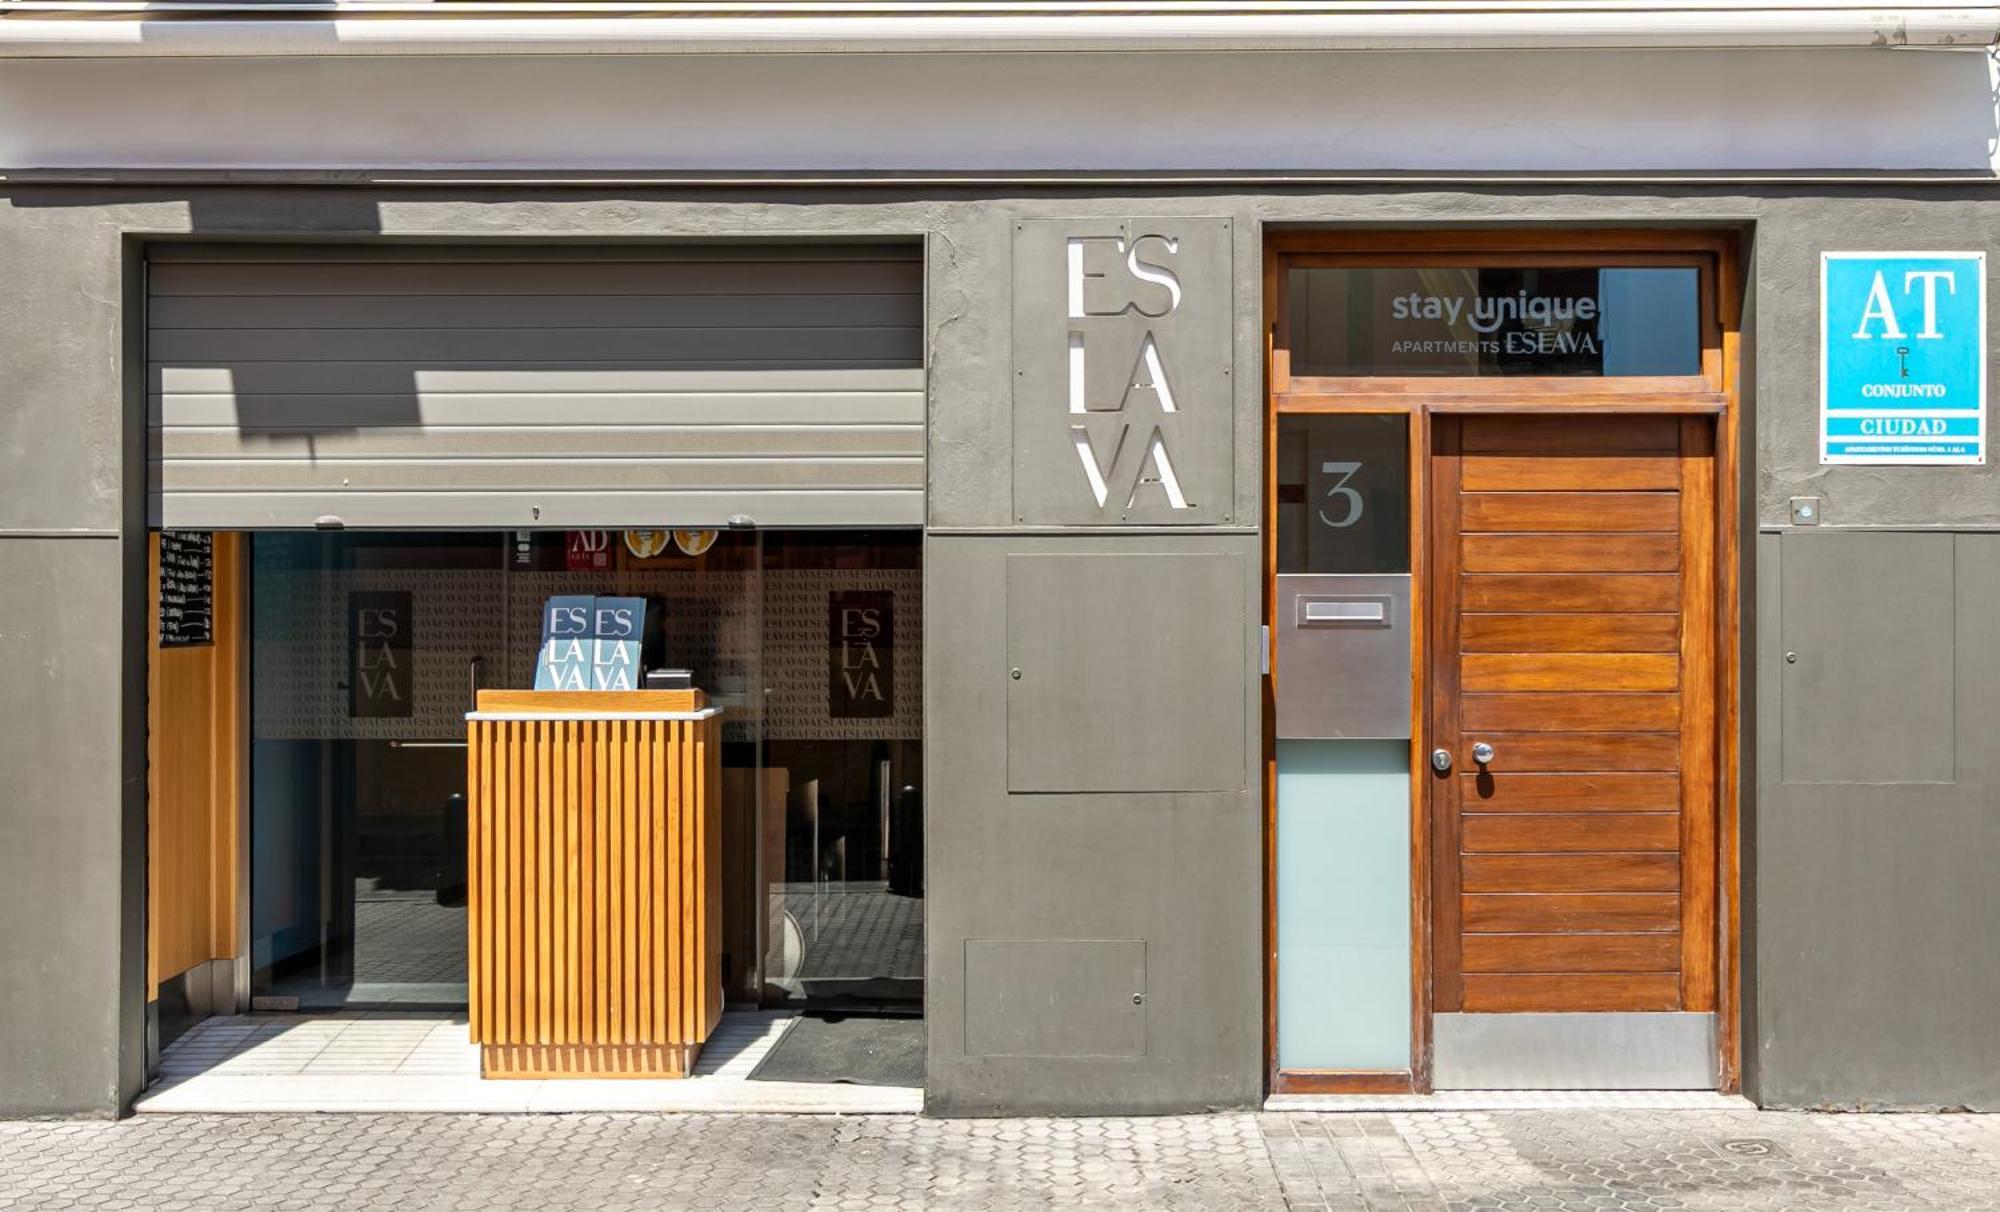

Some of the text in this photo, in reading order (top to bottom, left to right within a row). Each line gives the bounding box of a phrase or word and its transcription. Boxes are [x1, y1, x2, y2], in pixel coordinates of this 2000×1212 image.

[1067, 234, 1181, 317] ES
[1391, 289, 1597, 333] stay unique
[1851, 269, 1956, 340] AT
[1391, 330, 1598, 355] APARTMENTS ESLAVA
[1068, 329, 1180, 414] LA
[1861, 383, 1947, 398] CONJUNTO
[1859, 418, 1948, 435] CIUDAD
[1069, 424, 1197, 509] VA
[1318, 461, 1364, 528] 3
[356, 608, 399, 638] ES
[550, 607, 588, 634] ES
[595, 608, 633, 636] ES
[841, 608, 881, 638] ES
[357, 639, 397, 669] LA
[548, 636, 585, 662] LA
[593, 637, 631, 665] LA
[841, 639, 880, 670] LA
[359, 671, 402, 700] VA
[548, 663, 586, 690] VA
[594, 665, 632, 691] VA
[842, 671, 885, 701] VA
